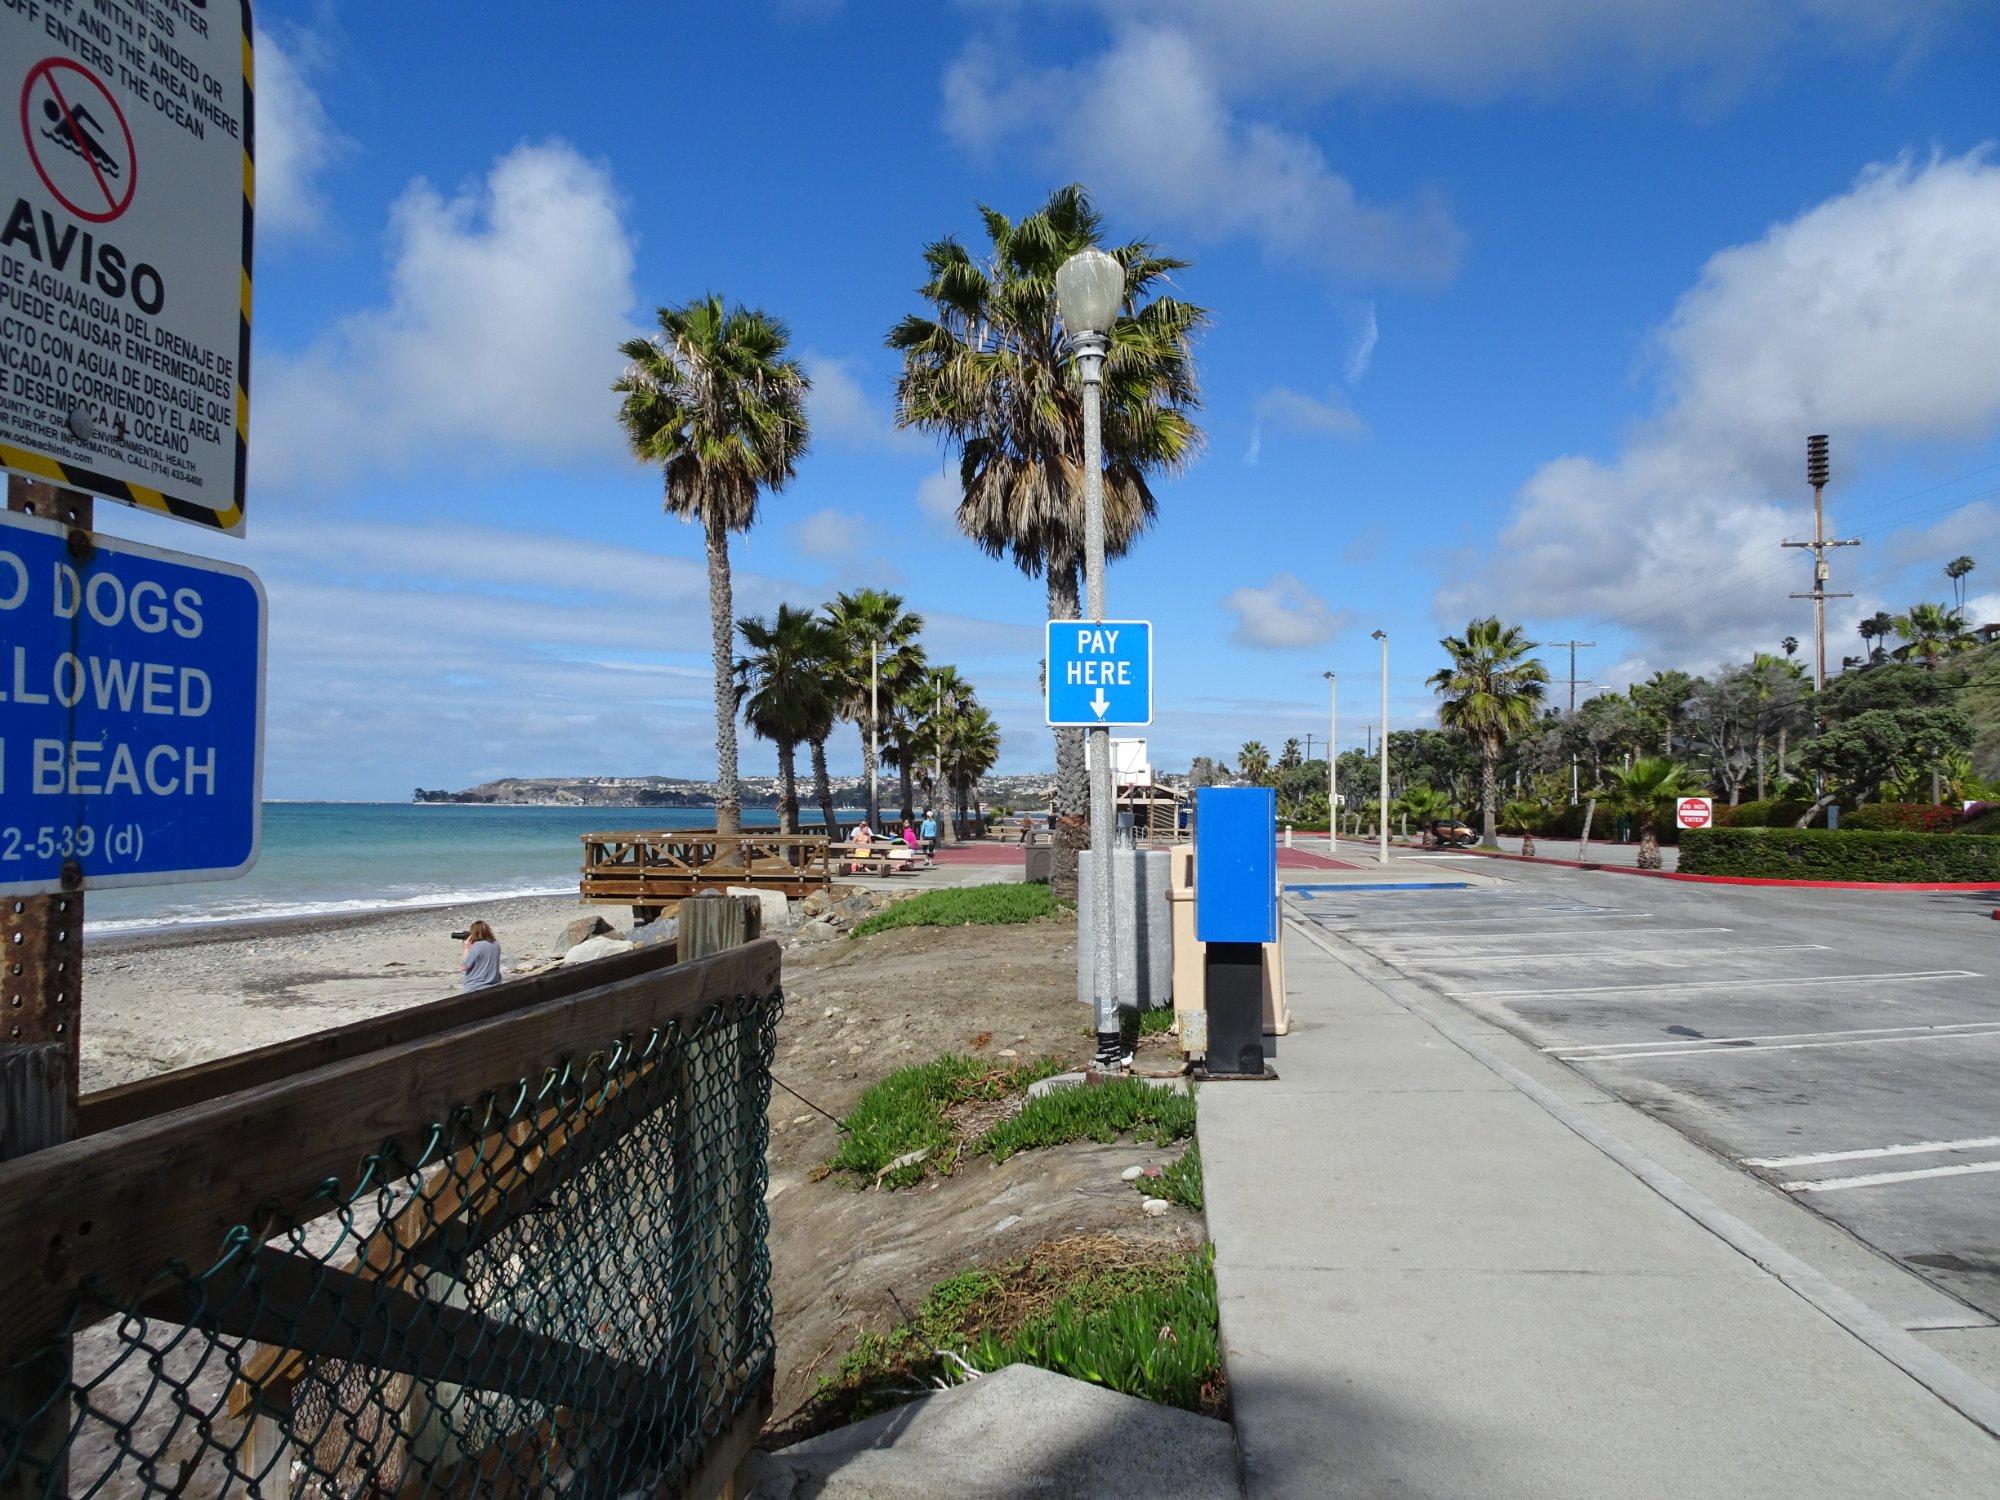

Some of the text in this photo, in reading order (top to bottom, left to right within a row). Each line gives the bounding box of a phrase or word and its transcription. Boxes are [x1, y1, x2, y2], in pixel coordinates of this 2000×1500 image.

[45, 12, 114, 77] ENTERS
[118, 62, 150, 103] THE
[153, 90, 205, 141] OCEAN
[78, 8, 112, 47] AND
[116, 33, 146, 73] THE
[149, 62, 189, 104] AREA
[191, 88, 239, 139] WHERE
[137, 22, 199, 84] PONDED
[203, 73, 224, 104] OR
[0, 197, 165, 316] AVISO
[1, 254, 25, 286] DE
[124, 312, 152, 343] DEL
[155, 327, 215, 372] DRENAJE
[217, 355, 234, 379] DE
[59, 309, 122, 355] CAUSAR
[125, 338, 231, 400] ENFERMEDADES
[40, 332, 74, 364] CON
[77, 348, 119, 382] AGUA
[121, 365, 141, 391] DE
[206, 400, 232, 427] QUE
[57, 365, 68, 388] O
[72, 371, 156, 420] CORRIENDO
[158, 403, 168, 424] Y
[170, 408, 186, 433] EL
[188, 416, 222, 446] AREA
[11, 415, 59, 441] FURTHER
[127, 453, 150, 471] CALL
[34, 408, 48, 423] OF
[165, 453, 197, 473] HEALTH
[134, 418, 189, 455] OCEANO
[53, 561, 204, 639] DOGS
[1067, 660, 1131, 685] HERE
[1078, 629, 1120, 654] PAY
[32, 737, 216, 796] BEACH
[104, 822, 144, 864] (d)
